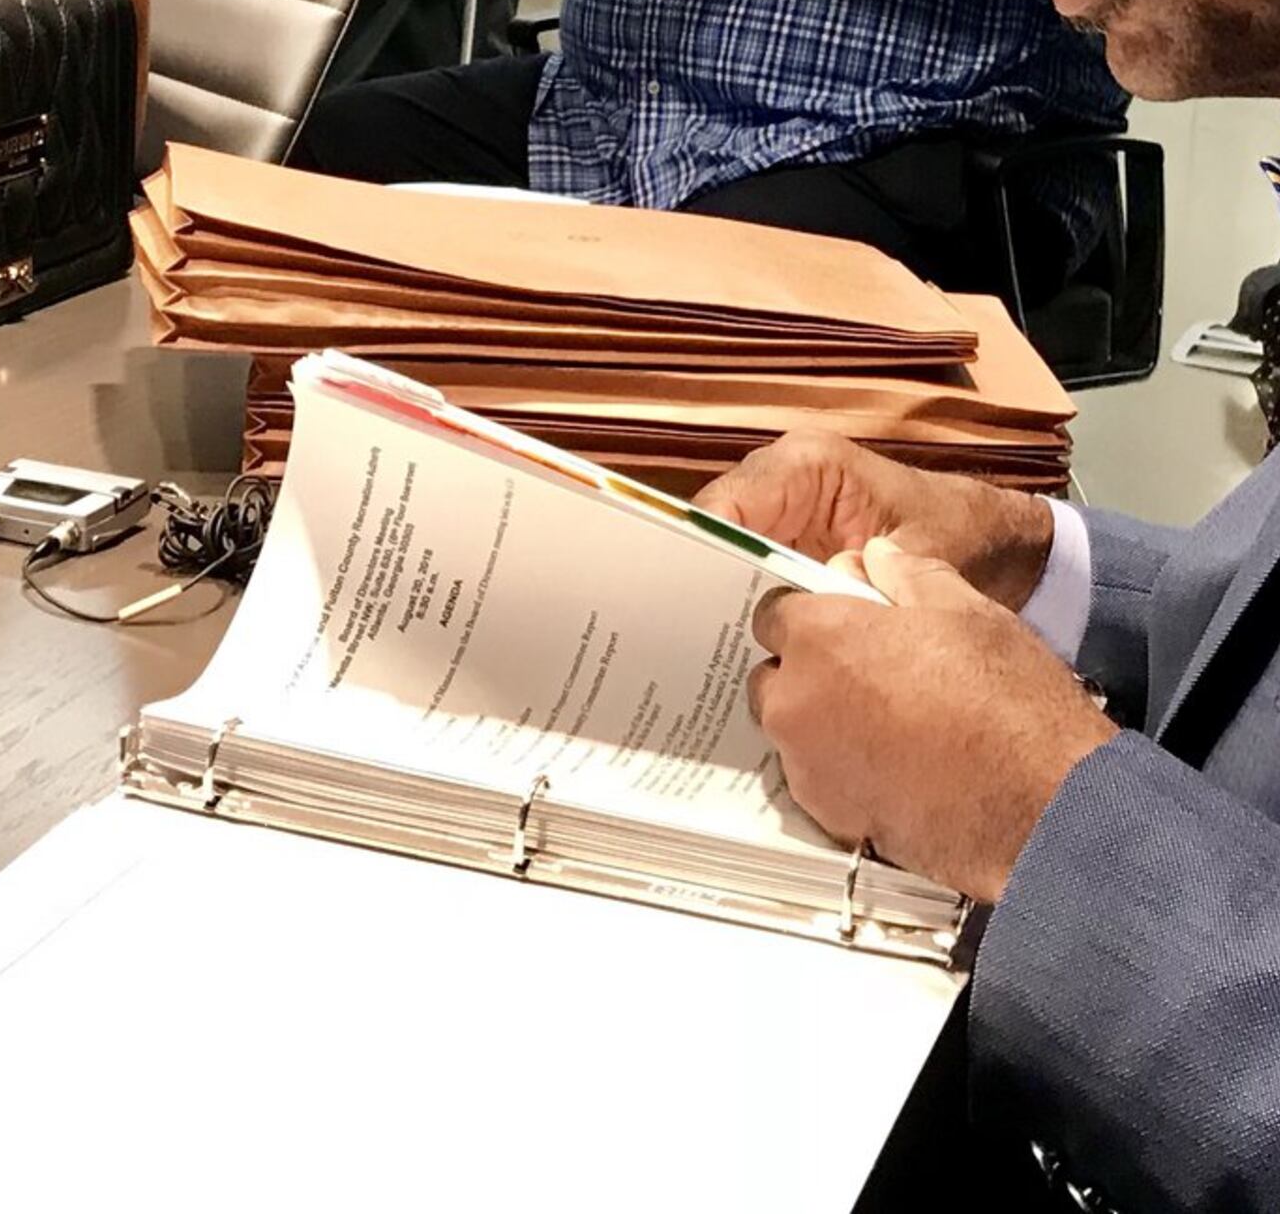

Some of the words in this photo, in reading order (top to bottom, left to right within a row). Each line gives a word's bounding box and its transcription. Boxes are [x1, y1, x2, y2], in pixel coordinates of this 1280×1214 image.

[352, 478, 373, 531] Recreation
[393, 503, 406, 527] Floor
[374, 507, 395, 546] Meeting
[338, 533, 360, 573] County
[418, 548, 433, 574] 2018
[356, 547, 381, 597] Directors
[369, 571, 386, 598] Suite
[411, 577, 426, 593] 20,
[323, 575, 344, 611] Fulton
[354, 597, 362, 610] of
[367, 601, 391, 641] Atlanta,
[383, 555, 405, 597] Georgia
[415, 595, 430, 620] 8:30
[426, 572, 440, 594] a.m.
[439, 579, 463, 628] AGENDA
[465, 600, 482, 629] Board
[477, 587, 486, 601] of
[317, 613, 330, 634] and
[338, 610, 358, 642] Board
[361, 601, 378, 622] NW,
[397, 595, 418, 633] August
[581, 610, 597, 641] Report
[347, 623, 368, 654] Street
[600, 631, 619, 665] Report
[722, 630, 744, 671] Funding
[329, 655, 352, 688] Marietta
[731, 646, 752, 686] Request
[696, 673, 714, 703] Board
